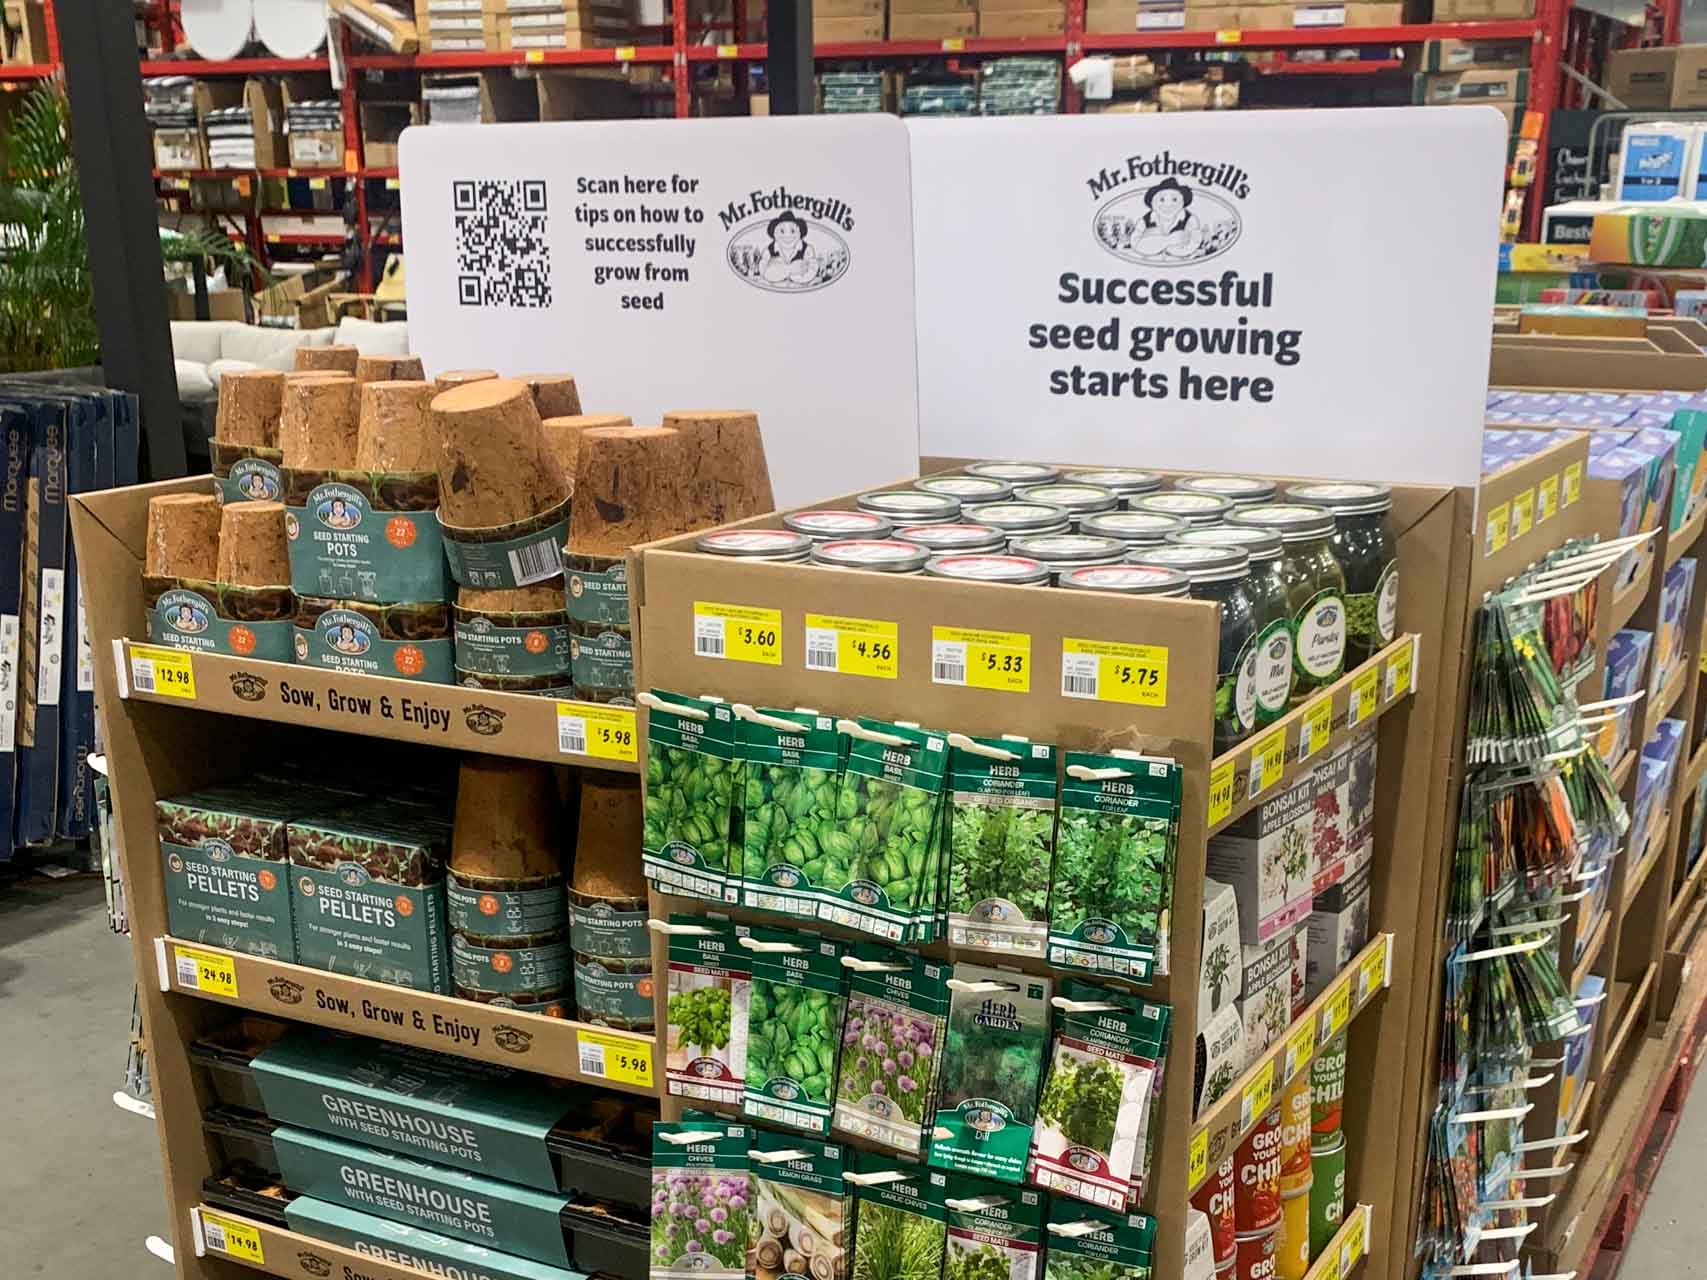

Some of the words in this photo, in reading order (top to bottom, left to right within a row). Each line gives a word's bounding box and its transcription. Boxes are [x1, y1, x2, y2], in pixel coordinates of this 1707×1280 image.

[576, 176, 619, 194] Scan
[624, 175, 667, 194] here
[671, 174, 699, 194] for
[574, 204, 609, 227] tips
[613, 207, 636, 223] on
[640, 203, 679, 223] how
[684, 206, 705, 223] to
[584, 233, 696, 258] successfully
[594, 264, 641, 284] grow
[644, 262, 690, 282] from
[1057, 270, 1274, 308] Successful
[621, 291, 664, 310] seed
[1028, 317, 1121, 351] seed
[1129, 316, 1303, 366] growing
[1049, 365, 1169, 399] starts
[1179, 366, 1275, 404] here
[313, 530, 338, 542] SEED
[339, 532, 370, 545] STARTING
[327, 543, 358, 557] POTS
[162, 632, 184, 643] SEED
[185, 634, 216, 647] STARTING
[500, 636, 523, 645] POTS
[321, 653, 344, 665] SEED
[346, 656, 378, 670] STARTING
[981, 652, 1023, 672] $5.33
[1114, 664, 1159, 686] $5.75
[280, 681, 321, 712] Sow,
[327, 687, 373, 716] Grow
[380, 697, 395, 719] &
[401, 698, 450, 732] Enjoy
[677, 719, 704, 735] HERB
[777, 735, 806, 748] HERB
[882, 750, 911, 766] HERB
[989, 765, 1020, 778] HERB
[1101, 781, 1134, 795] HERB
[1094, 794, 1139, 807] CORIANDER
[1263, 791, 1297, 820] BONSAI
[185, 860, 209, 875] SEED
[210, 865, 257, 883] STARTING
[187, 873, 260, 902] PELLETS
[318, 884, 342, 899] SEED
[344, 889, 393, 909] STARTING
[319, 897, 396, 928] PELLETS
[621, 919, 643, 928] POTS
[698, 939, 725, 952] HERB
[782, 956, 810, 969] HERB
[885, 974, 912, 990] HERB
[316, 989, 355, 1017] Sow,
[362, 999, 404, 1027] Grow
[412, 1010, 426, 1032] &
[432, 1013, 480, 1046] Enjoy
[981, 999, 1018, 1020] HERB
[974, 1014, 1023, 1031] GARDEN
[1098, 1016, 1127, 1033] HERB
[1089, 1028, 1130, 1045] CORIANDER
[1314, 1053, 1345, 1073] GRO
[321, 1093, 479, 1149] GREENHOUSE
[327, 1113, 358, 1130] WITH
[360, 1121, 390, 1138] SEED
[391, 1129, 449, 1154] STARTING
[450, 1144, 482, 1162] POTS
[1252, 1126, 1281, 1151] GRO
[686, 1143, 716, 1154] HERB
[687, 1155, 714, 1163] CHIVES
[787, 1159, 814, 1172] HERB
[778, 1170, 800, 1180] LEMON
[800, 1172, 823, 1185] GRASS
[340, 1165, 492, 1224] GREENHOUSE
[891, 1182, 919, 1198] HERB
[344, 1185, 373, 1204] WITH
[375, 1194, 406, 1210] SEED
[407, 1202, 462, 1229] STARTING
[463, 1219, 495, 1238] POTS
[902, 1198, 928, 1211] CHIVES
[981, 1206, 1009, 1220] HERB
[1084, 1229, 1114, 1243] HERB
[1077, 1240, 1120, 1255] CORIANDER
